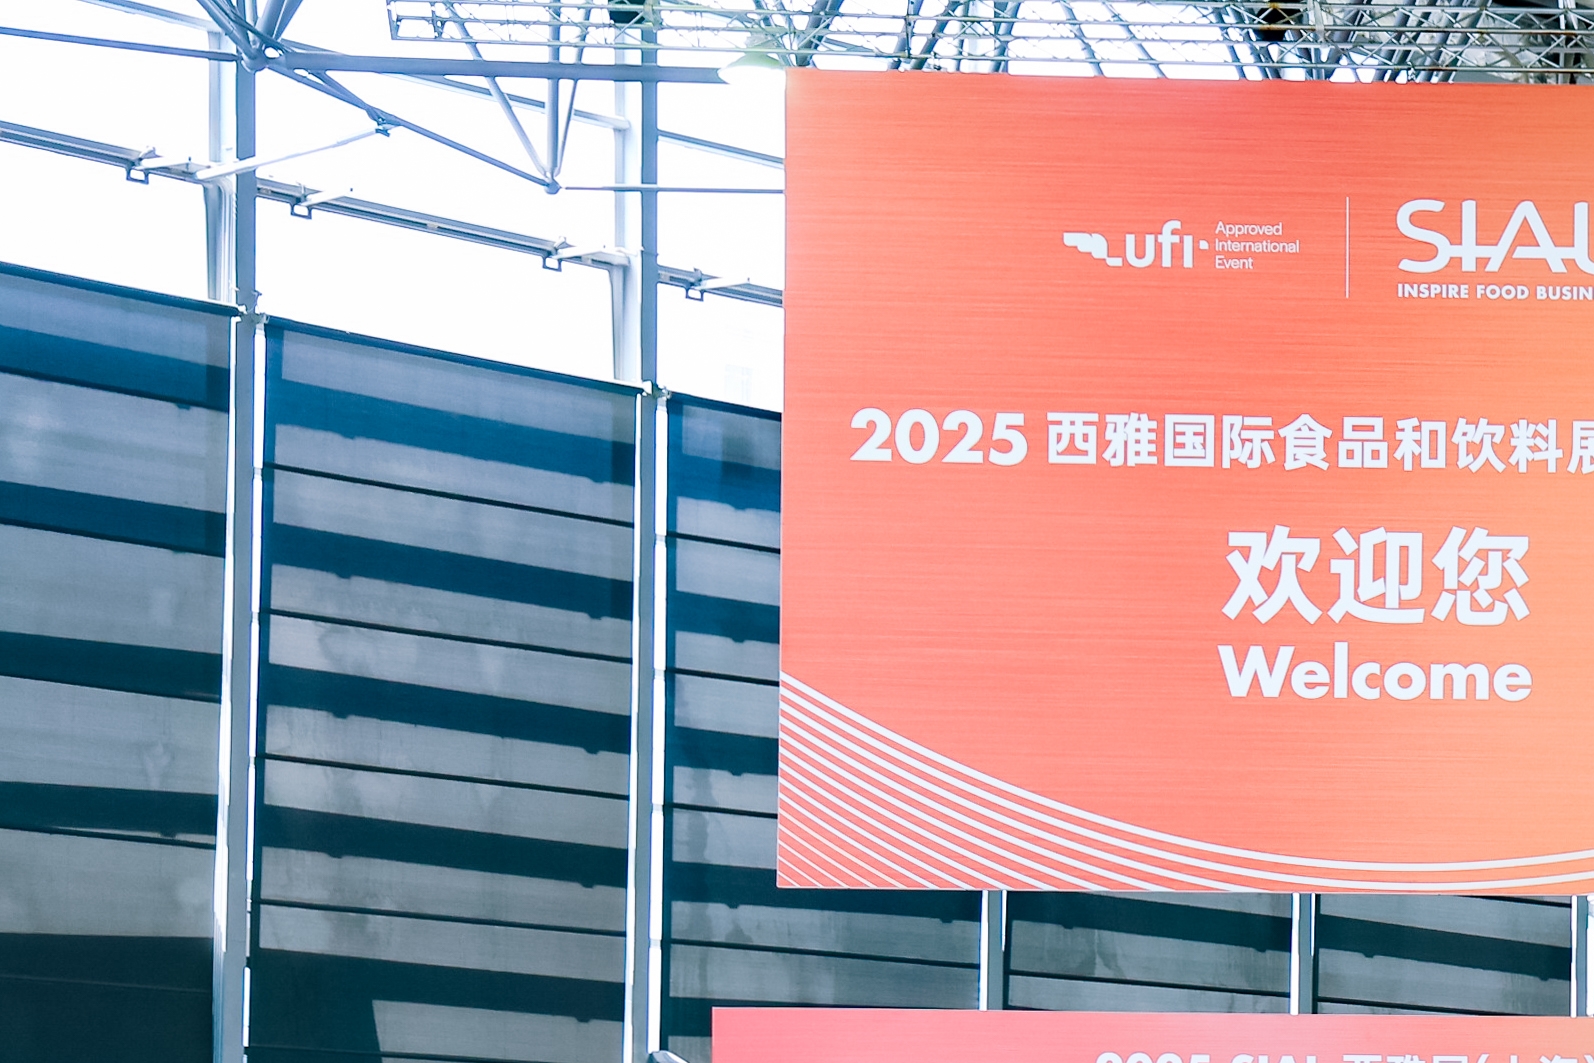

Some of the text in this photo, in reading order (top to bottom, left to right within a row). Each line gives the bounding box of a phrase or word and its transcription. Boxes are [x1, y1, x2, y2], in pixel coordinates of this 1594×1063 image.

[1214, 220, 1283, 238] Approved
[1214, 238, 1300, 254] International
[1214, 256, 1254, 270] Event
[1397, 283, 1469, 299] INSPIRE
[1475, 284, 1529, 300] FOOD
[850, 408, 1027, 467] 2025
[1221, 525, 1531, 627] 欢迎您
[1217, 640, 1533, 702] Welcome
